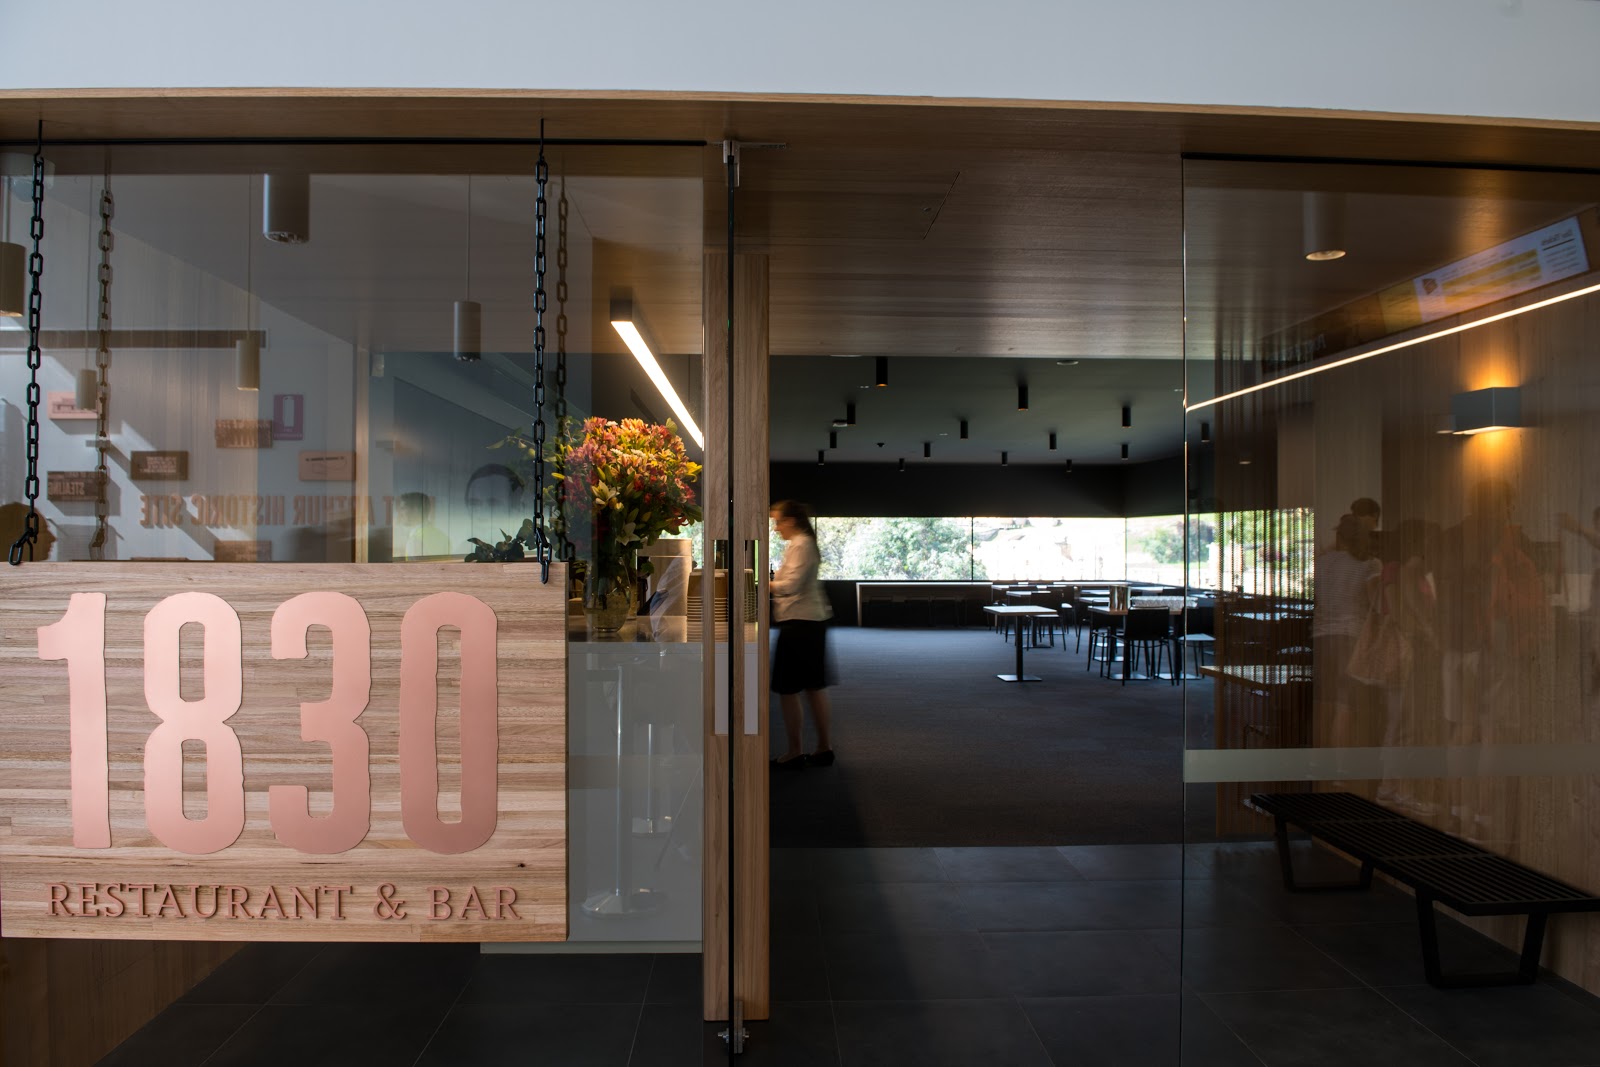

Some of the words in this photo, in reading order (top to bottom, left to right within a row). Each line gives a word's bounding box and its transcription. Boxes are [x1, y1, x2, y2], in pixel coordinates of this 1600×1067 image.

[36, 591, 499, 855] 1830
[47, 882, 353, 920] RESTAURANT
[374, 881, 406, 920] &
[427, 886, 522, 922] BAR
